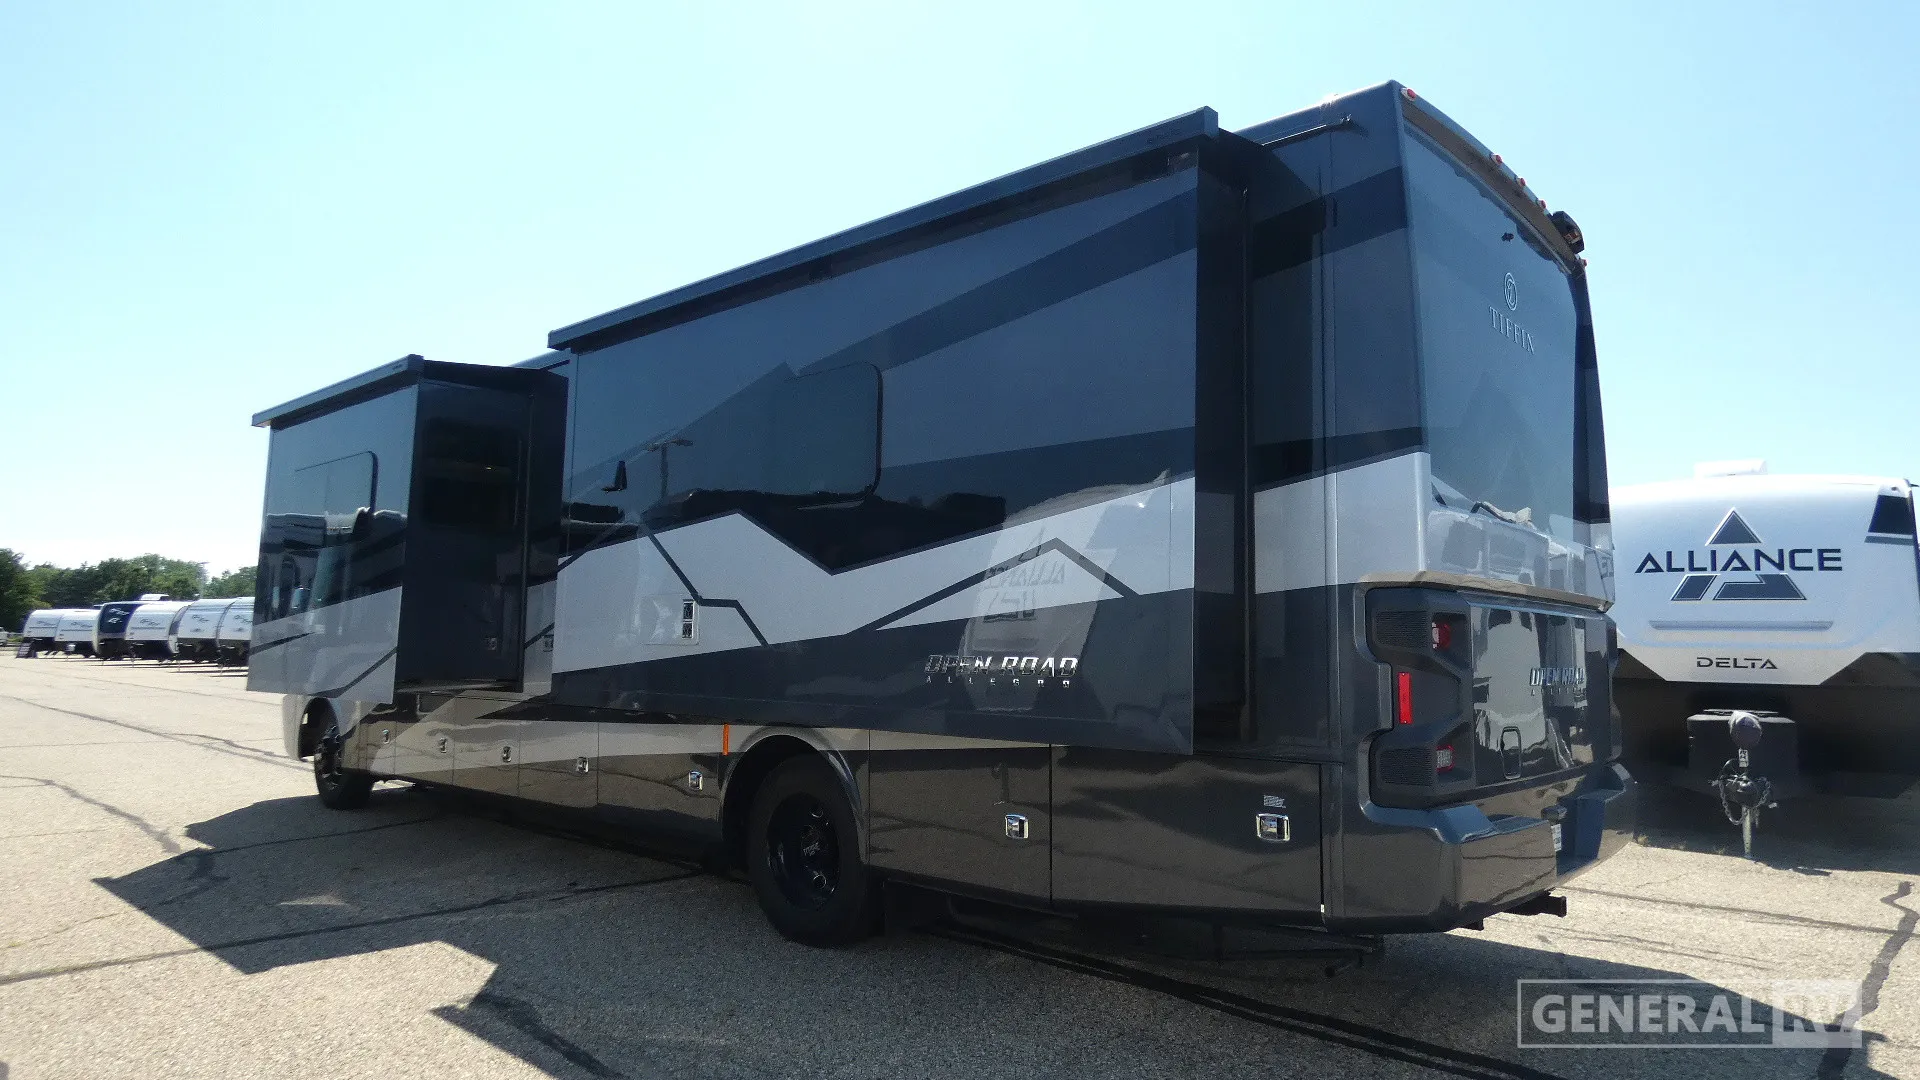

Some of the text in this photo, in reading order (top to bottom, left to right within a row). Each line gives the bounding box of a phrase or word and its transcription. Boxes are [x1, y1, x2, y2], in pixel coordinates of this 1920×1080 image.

[1489, 306, 1535, 355] TIFFIN
[1635, 548, 1843, 573] ALLIANCE
[925, 654, 1079, 678] OPEN ROAD
[1696, 656, 1778, 669] DELTA
